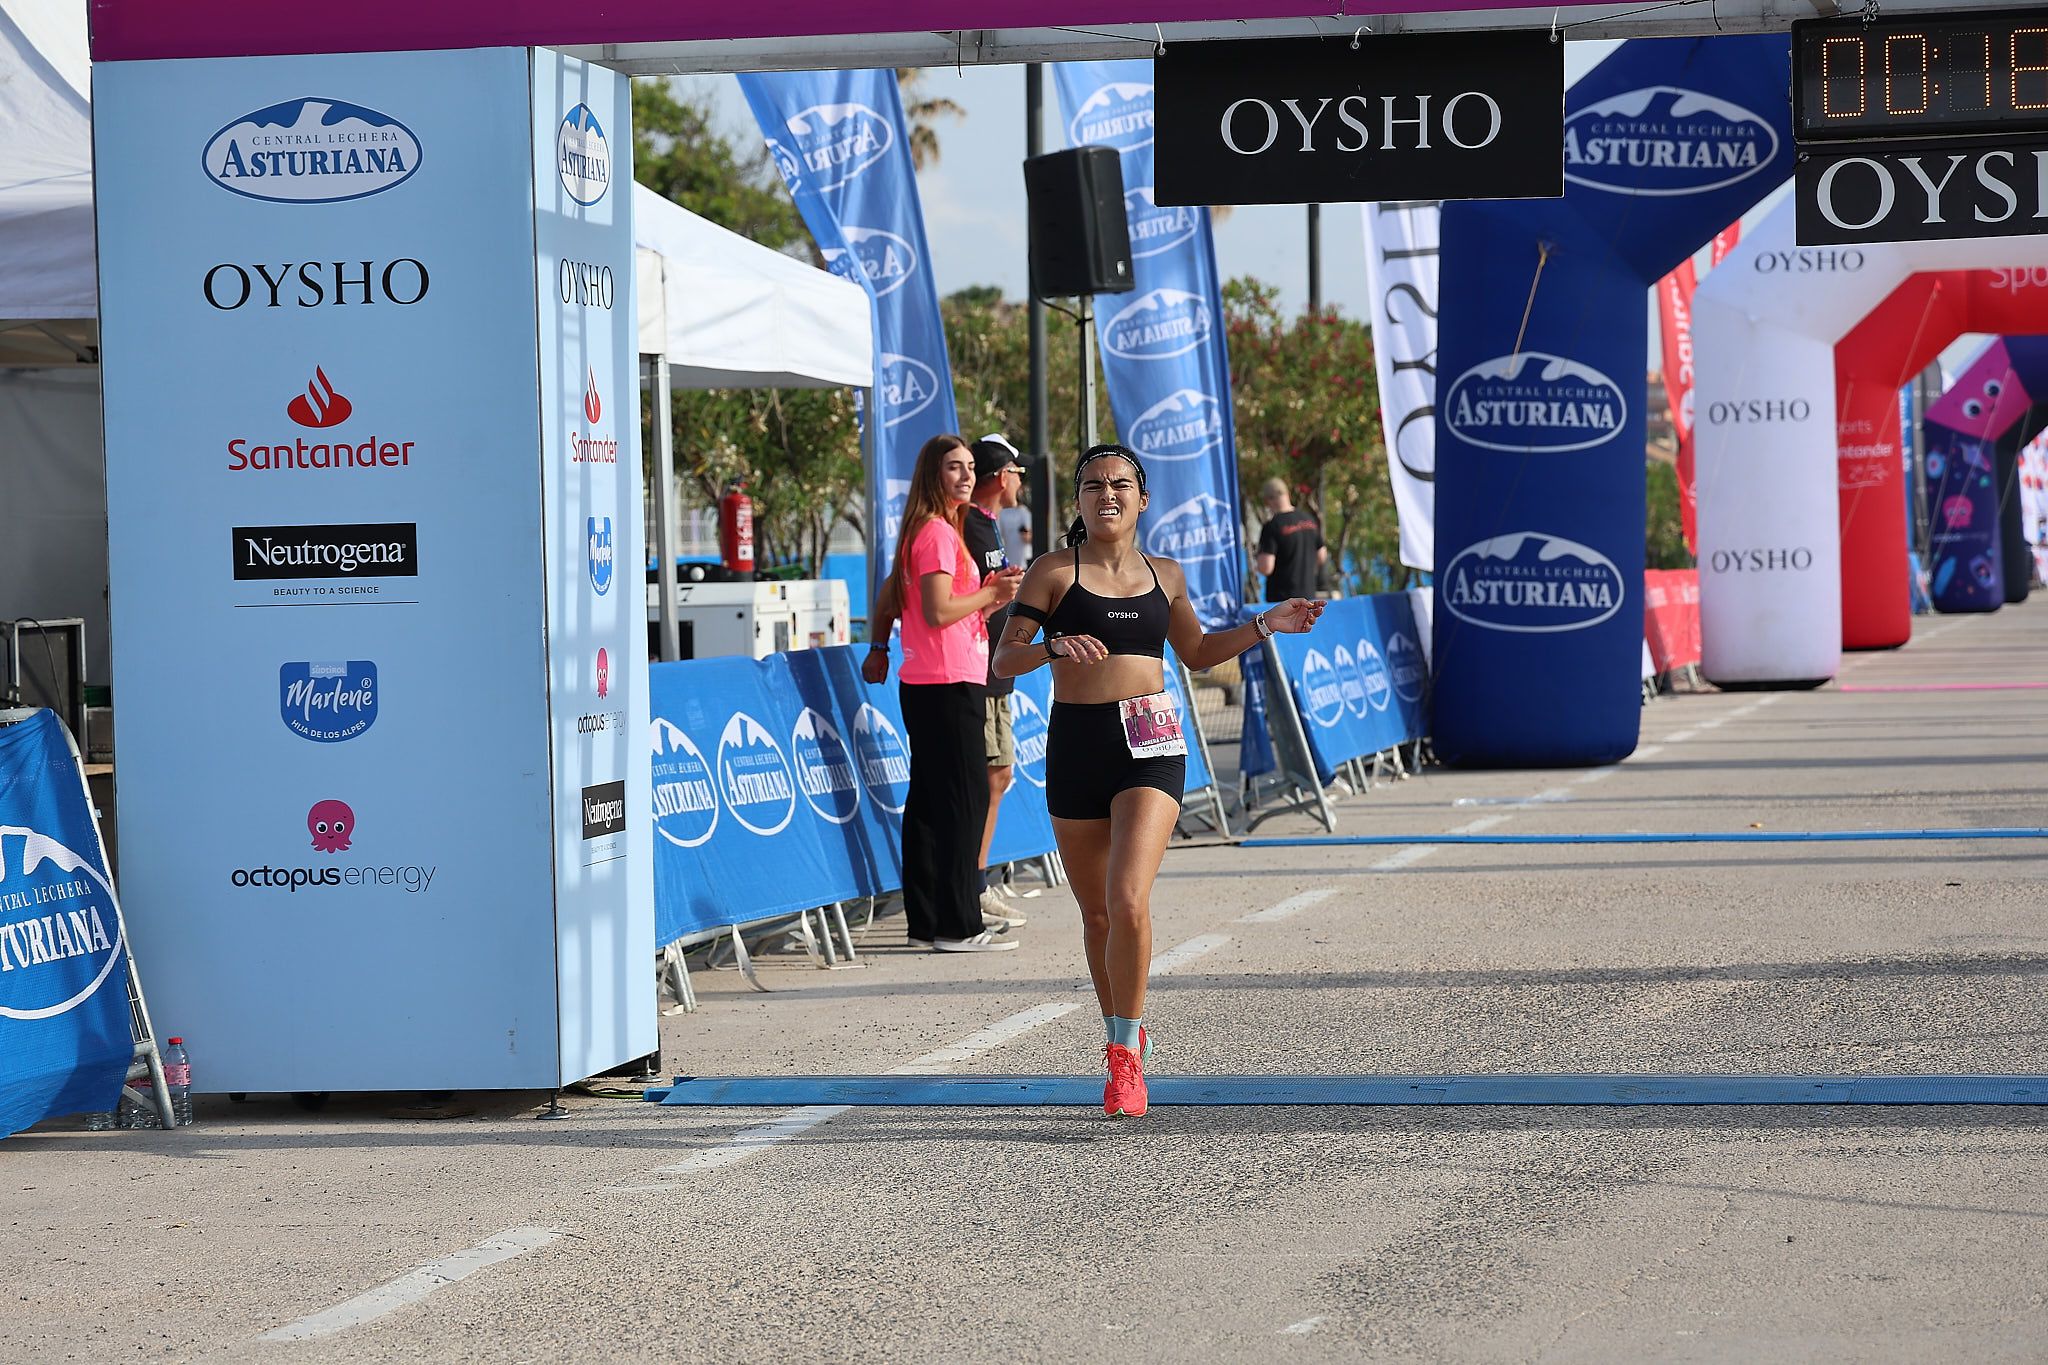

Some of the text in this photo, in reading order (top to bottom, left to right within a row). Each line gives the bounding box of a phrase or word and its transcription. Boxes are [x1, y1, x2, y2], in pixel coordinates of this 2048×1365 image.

[252, 132, 399, 146] CENTRAL LECHERA
[1220, 91, 1502, 155] OYSHO
[1591, 123, 1756, 137] CENTRAL LECHERA
[219, 138, 408, 178] ASTURIANA
[561, 136, 607, 183] ASTURIANA
[1564, 126, 1758, 168] ASTURIANA
[1816, 151, 2048, 230] OYS
[1754, 250, 1864, 274] OYSHO
[203, 258, 430, 310] OYSHO
[559, 258, 614, 310] OYSHO
[1477, 386, 1611, 399] CENTRAL LECHERA
[1453, 389, 1616, 429] ASTURIANA
[1708, 399, 1810, 425] OYSHO
[228, 436, 415, 471] Santander
[571, 431, 618, 463] Santander
[244, 537, 406, 572] Neutrogena
[1711, 547, 1813, 574] OYSHO
[1475, 565, 1609, 578] CENTRAL LECHERA
[273, 586, 380, 596] BEAUTY TO A SCIENCE
[1451, 567, 1613, 609] ASTURIANA
[1107, 611, 1139, 619] OYSHO
[291, 719, 366, 739] HIJA DE LOS ALPES
[725, 760, 792, 806] ASTURIANA
[584, 797, 624, 829] Neutrogena
[32, 879, 92, 904] LECHERA
[231, 865, 436, 893] octopus energy
